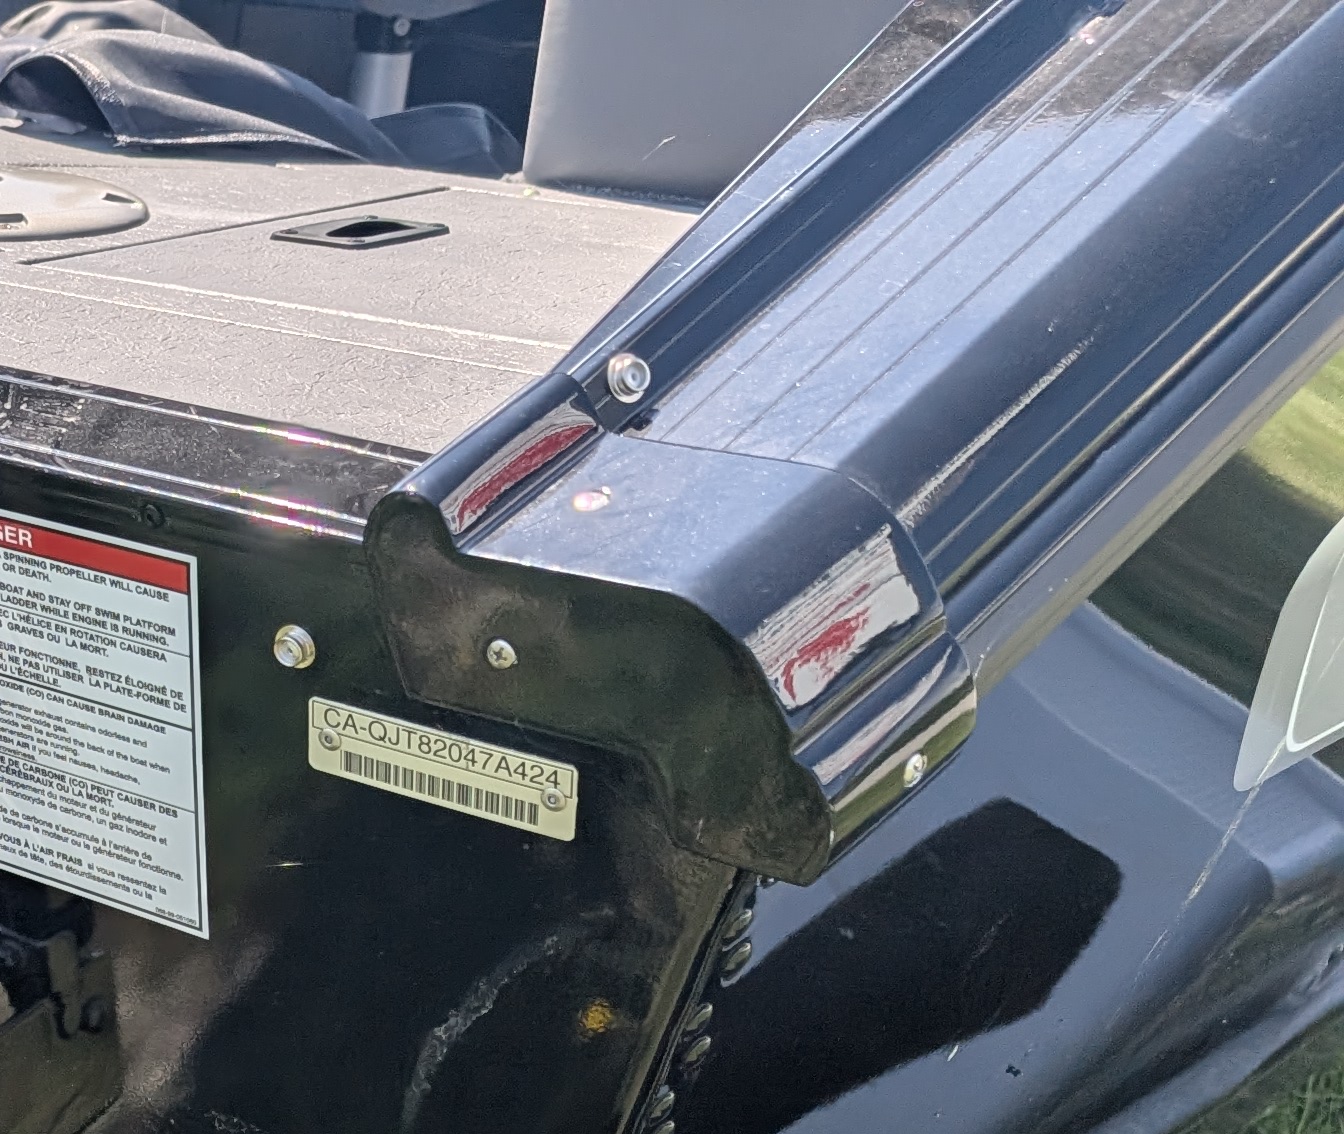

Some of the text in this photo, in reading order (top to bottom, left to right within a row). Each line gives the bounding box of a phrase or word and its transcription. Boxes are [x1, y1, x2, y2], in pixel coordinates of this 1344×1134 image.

[2, 563, 16, 573] OR
[18, 566, 51, 583] DEATH.
[3, 552, 47, 570] SPINNING
[50, 563, 107, 586] PROPELLER
[109, 578, 133, 593] WILL
[135, 585, 169, 602] CAUSE
[0, 582, 24, 595] BOAT
[26, 589, 46, 601] AND
[48, 595, 71, 608] STAY
[74, 602, 92, 613] OFF
[95, 607, 120, 622] SWIM
[123, 615, 176, 636] PLATFORM
[0, 593, 38, 611] LADDER
[40, 603, 69, 619] WHILE
[72, 612, 108, 630] ENGINE
[110, 623, 119, 633] IS
[122, 626, 169, 646] RUNNING.
[7, 622, 44, 639] GRAVES
[47, 633, 60, 644] OU
[65, 638, 78, 649] LA
[80, 642, 109, 657] MORT.
[11, 609, 52, 630] L'HÉLICE
[55, 624, 67, 635] EN
[70, 628, 117, 648] ROTATION
[120, 642, 167, 662] CAUSERA
[8, 654, 20, 665] NE
[23, 658, 40, 671] PAS
[43, 664, 84, 684] UTILISER
[89, 678, 101, 689] LA
[103, 682, 171, 709] PLATE-FORME
[173, 702, 187, 713] DE
[10, 666, 61, 688] L'ÉCHELLE.
[19, 646, 81, 673] FONCTIONNE,
[86, 665, 122, 684] RESTEZ
[125, 675, 167, 696] ÉLOIGNÉ
[170, 689, 184, 701] DE
[26, 687, 44, 700] (CO)
[46, 693, 64, 704] CAN
[67, 699, 96, 714] CAUSE
[98, 708, 125, 722] BRAIN
[128, 717, 166, 734] DAMAGE
[16, 741, 30, 750] AIR
[323, 707, 561, 789] CA-QJT82047A424
[0, 763, 54, 789] CÉRÉBRAUX
[56, 783, 69, 793] OU
[72, 787, 84, 799] LA
[86, 791, 114, 808] MORT.
[8, 758, 21, 770] DE
[22, 763, 66, 783] CARBONE
[69, 777, 88, 792] (CO)
[91, 784, 115, 798] PEUT
[117, 793, 156, 812] CAUSER
[159, 805, 178, 818] DES
[24, 839, 30, 849] À
[32, 843, 54, 857] L'AIR
[57, 851, 83, 867] FRAIS
